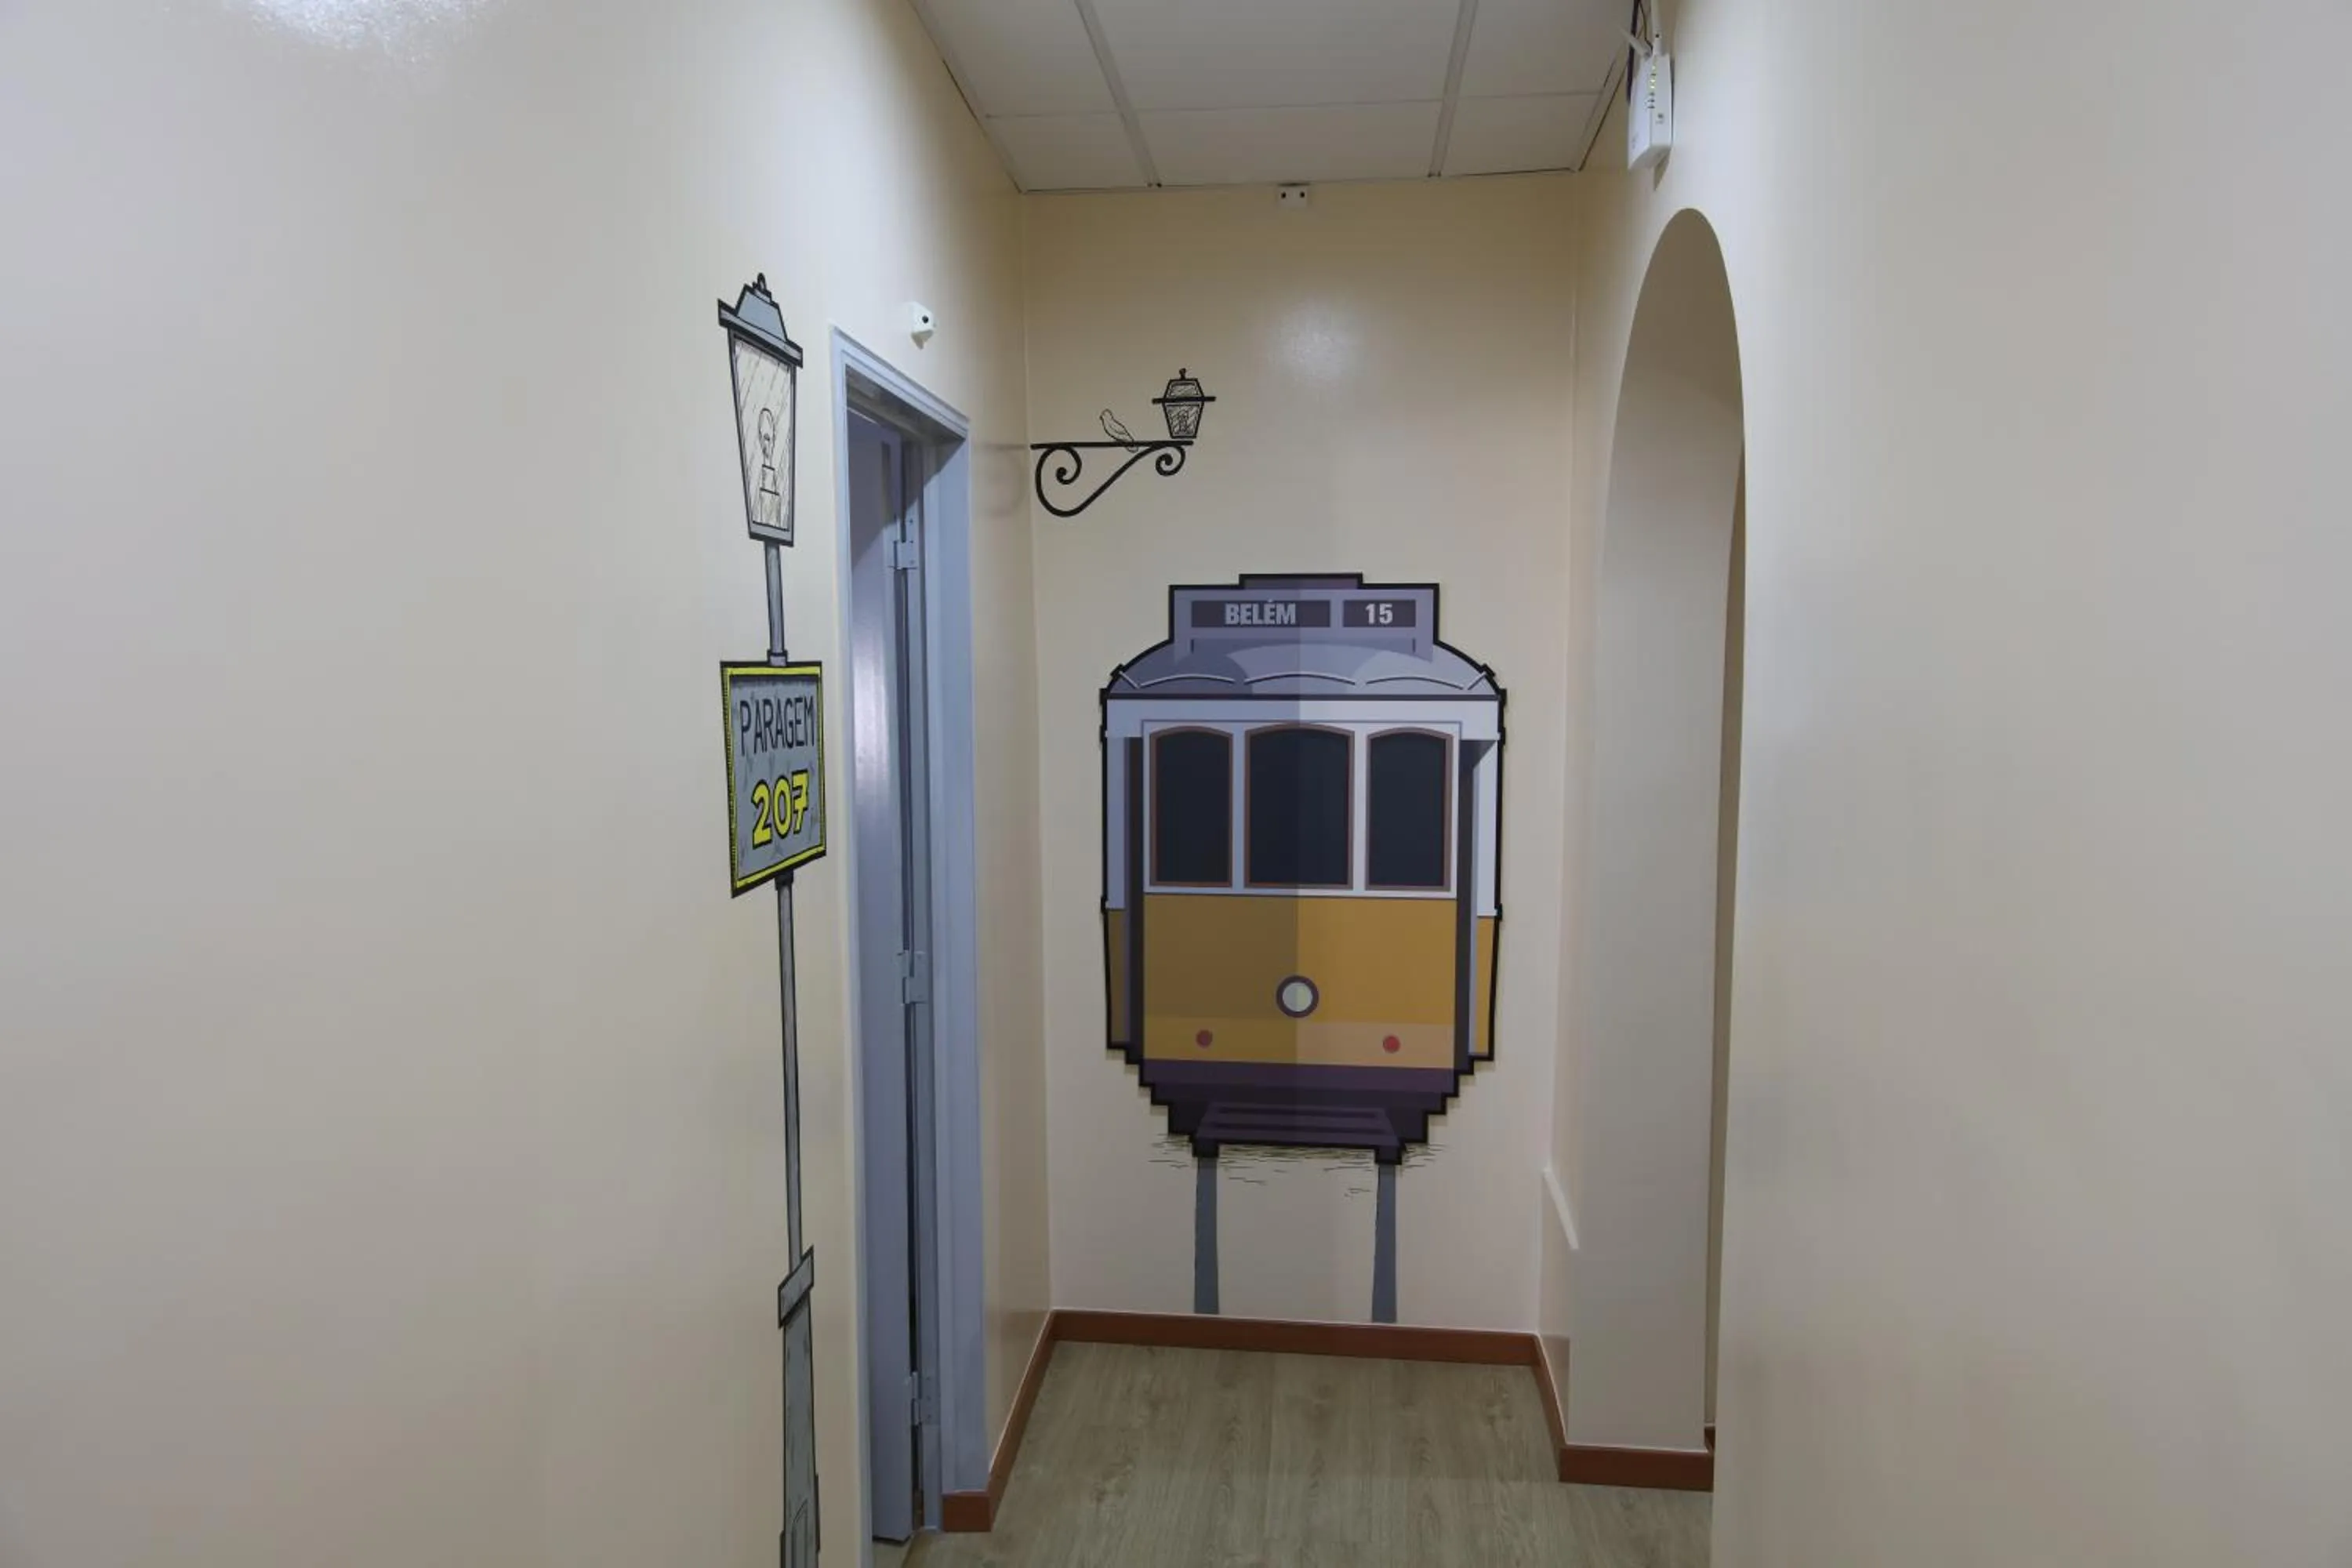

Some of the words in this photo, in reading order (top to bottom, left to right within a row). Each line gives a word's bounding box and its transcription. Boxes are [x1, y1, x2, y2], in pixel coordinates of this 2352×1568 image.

[1225, 599, 1297, 625] BELÉM
[1365, 603, 1393, 625] 15
[739, 695, 815, 757] PARAGEM
[751, 769, 810, 850] 207
